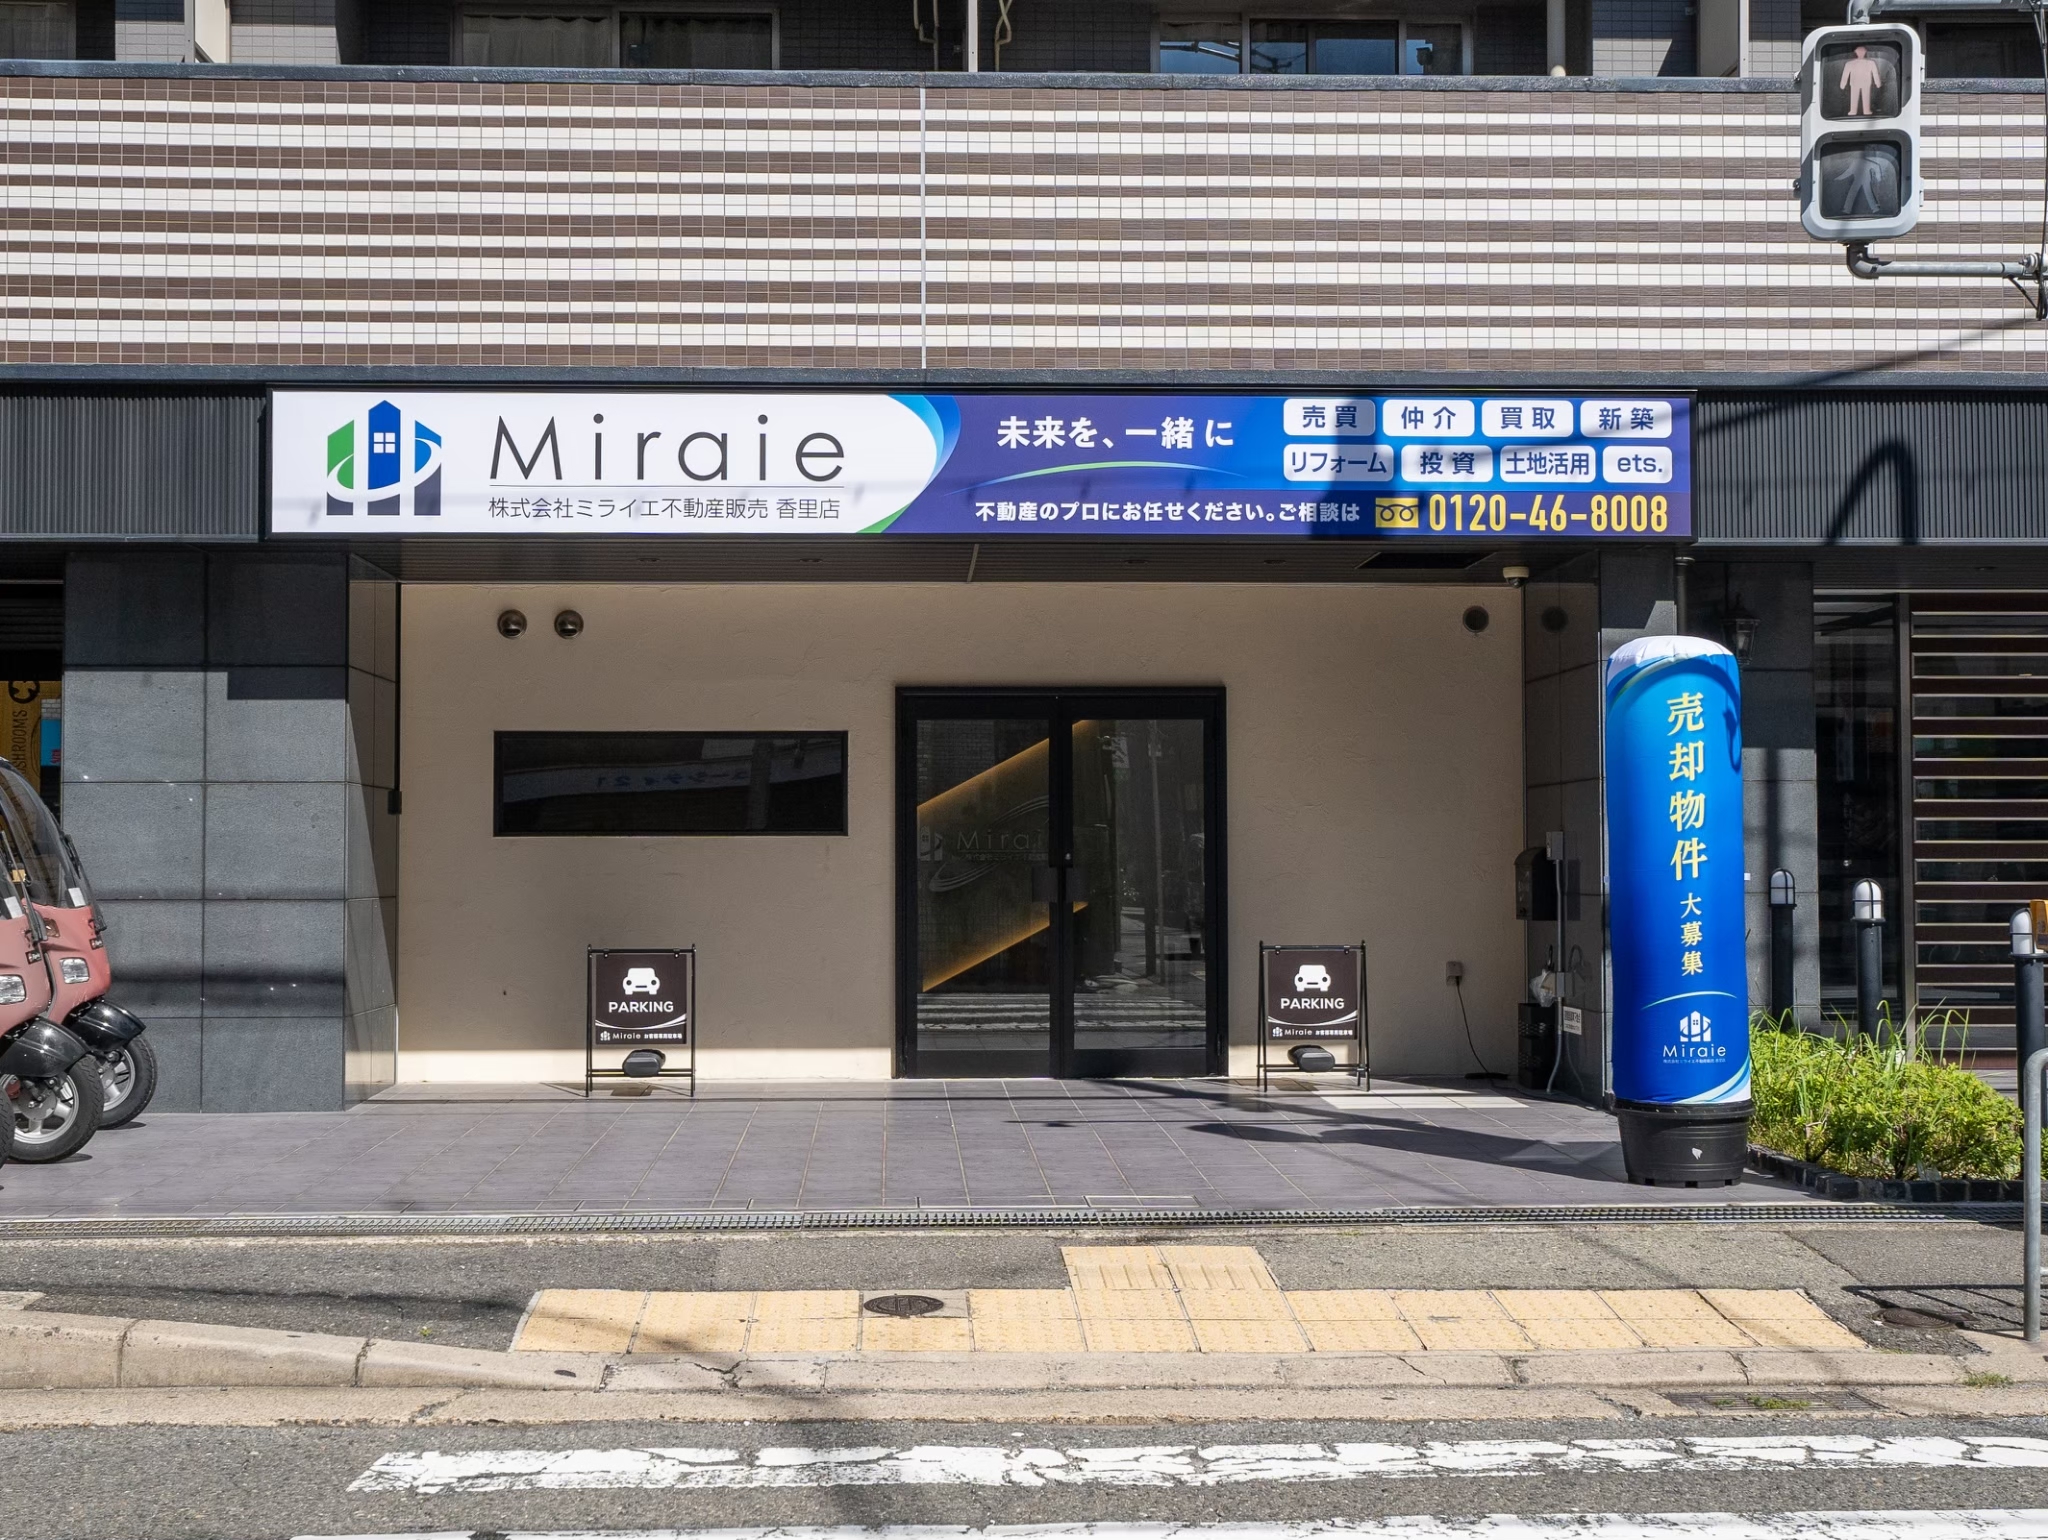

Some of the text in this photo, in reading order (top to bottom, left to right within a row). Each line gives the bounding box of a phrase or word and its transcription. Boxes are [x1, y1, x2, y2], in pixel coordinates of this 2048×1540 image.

[1301, 405, 1358, 429] 売買
[1400, 405, 1457, 430] 仲介
[1499, 406, 1556, 430] 買取
[1598, 406, 1655, 430] 新築
[997, 416, 1234, 449] 未来を、一緒に
[489, 413, 845, 482] Miraie
[1291, 452, 1387, 475] リフォーム
[1419, 452, 1476, 475] 投資
[1505, 452, 1590, 475] 土地活用
[1616, 454, 1663, 473] ets.
[488, 497, 841, 519] 株式会社ミライエ不動産販売 香里店
[975, 501, 1360, 522] 不動産のプロにお任せください。ご相談は
[1428, 493, 1668, 532] 0120-46-8008
[957, 829, 1045, 850] Mirai
[1666, 692, 1708, 976] 売却物件 大募集
[608, 1001, 674, 1013] PARKING
[1280, 998, 1345, 1009] PARKING
[1662, 1043, 1726, 1058] Miraie
